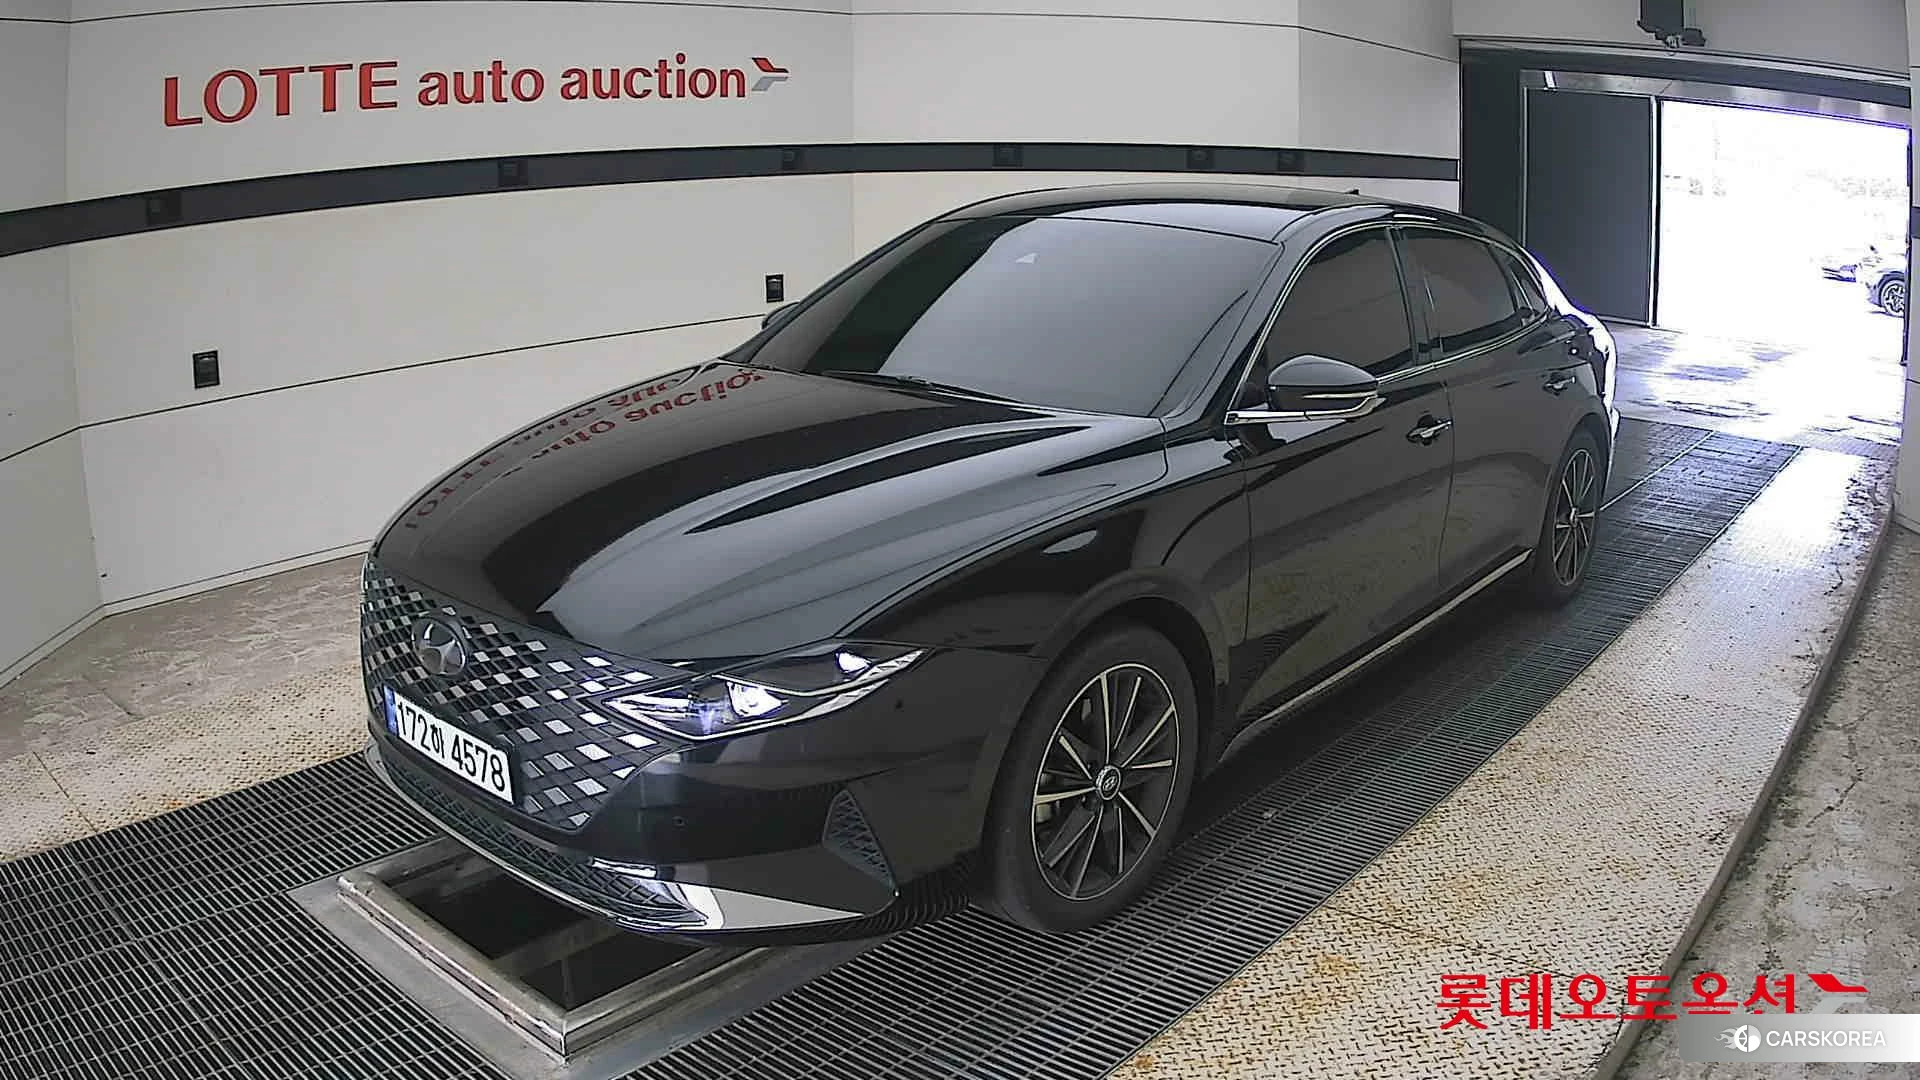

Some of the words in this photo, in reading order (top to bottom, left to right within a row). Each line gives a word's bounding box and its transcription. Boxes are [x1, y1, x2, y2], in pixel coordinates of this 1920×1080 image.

[163, 61, 399, 127] LOTTE
[417, 60, 545, 106] auto
[560, 52, 747, 100] auction
[398, 703, 445, 759] 172하
[451, 734, 506, 793] 4578
